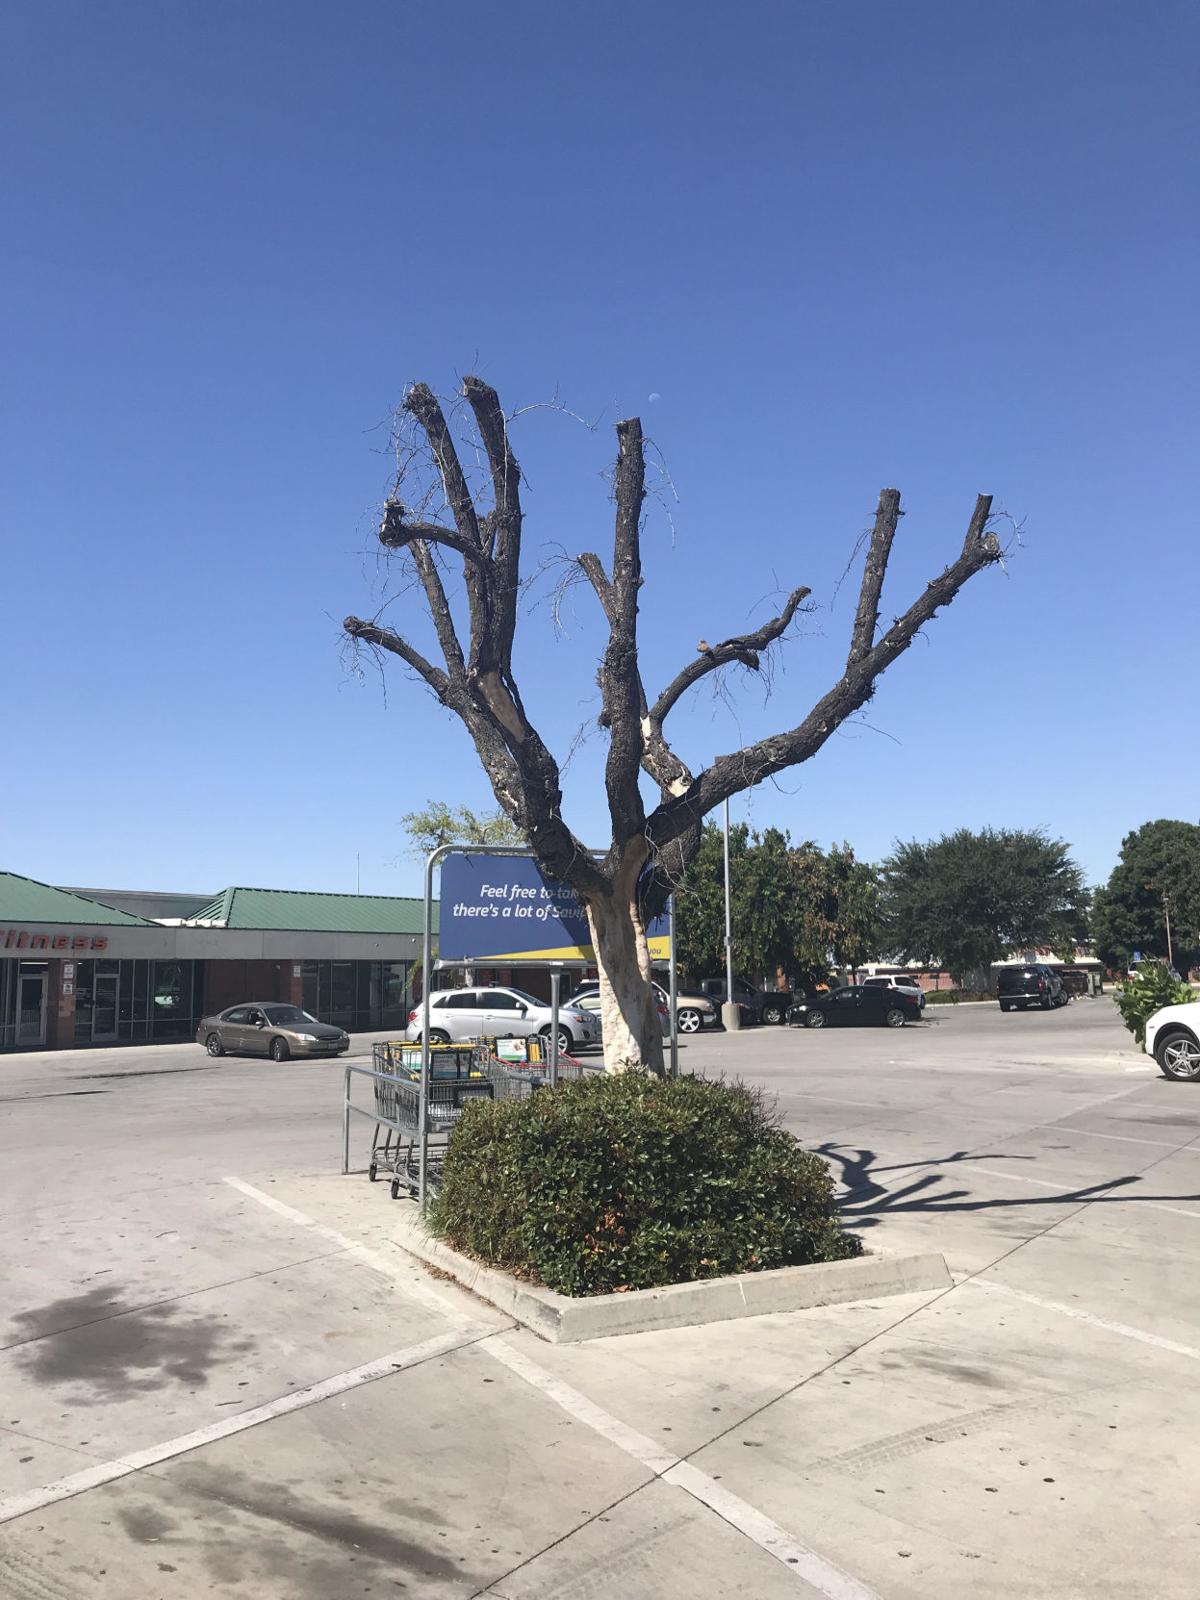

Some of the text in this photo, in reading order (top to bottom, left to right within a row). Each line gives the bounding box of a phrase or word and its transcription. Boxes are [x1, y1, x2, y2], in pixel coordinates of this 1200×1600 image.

[480, 884, 508, 898] Feel
[508, 884, 537, 901] free
[540, 886, 553, 899] to
[453, 903, 499, 917] there's
[502, 907, 512, 917] a
[514, 904, 533, 918] lot
[535, 904, 552, 921] of
